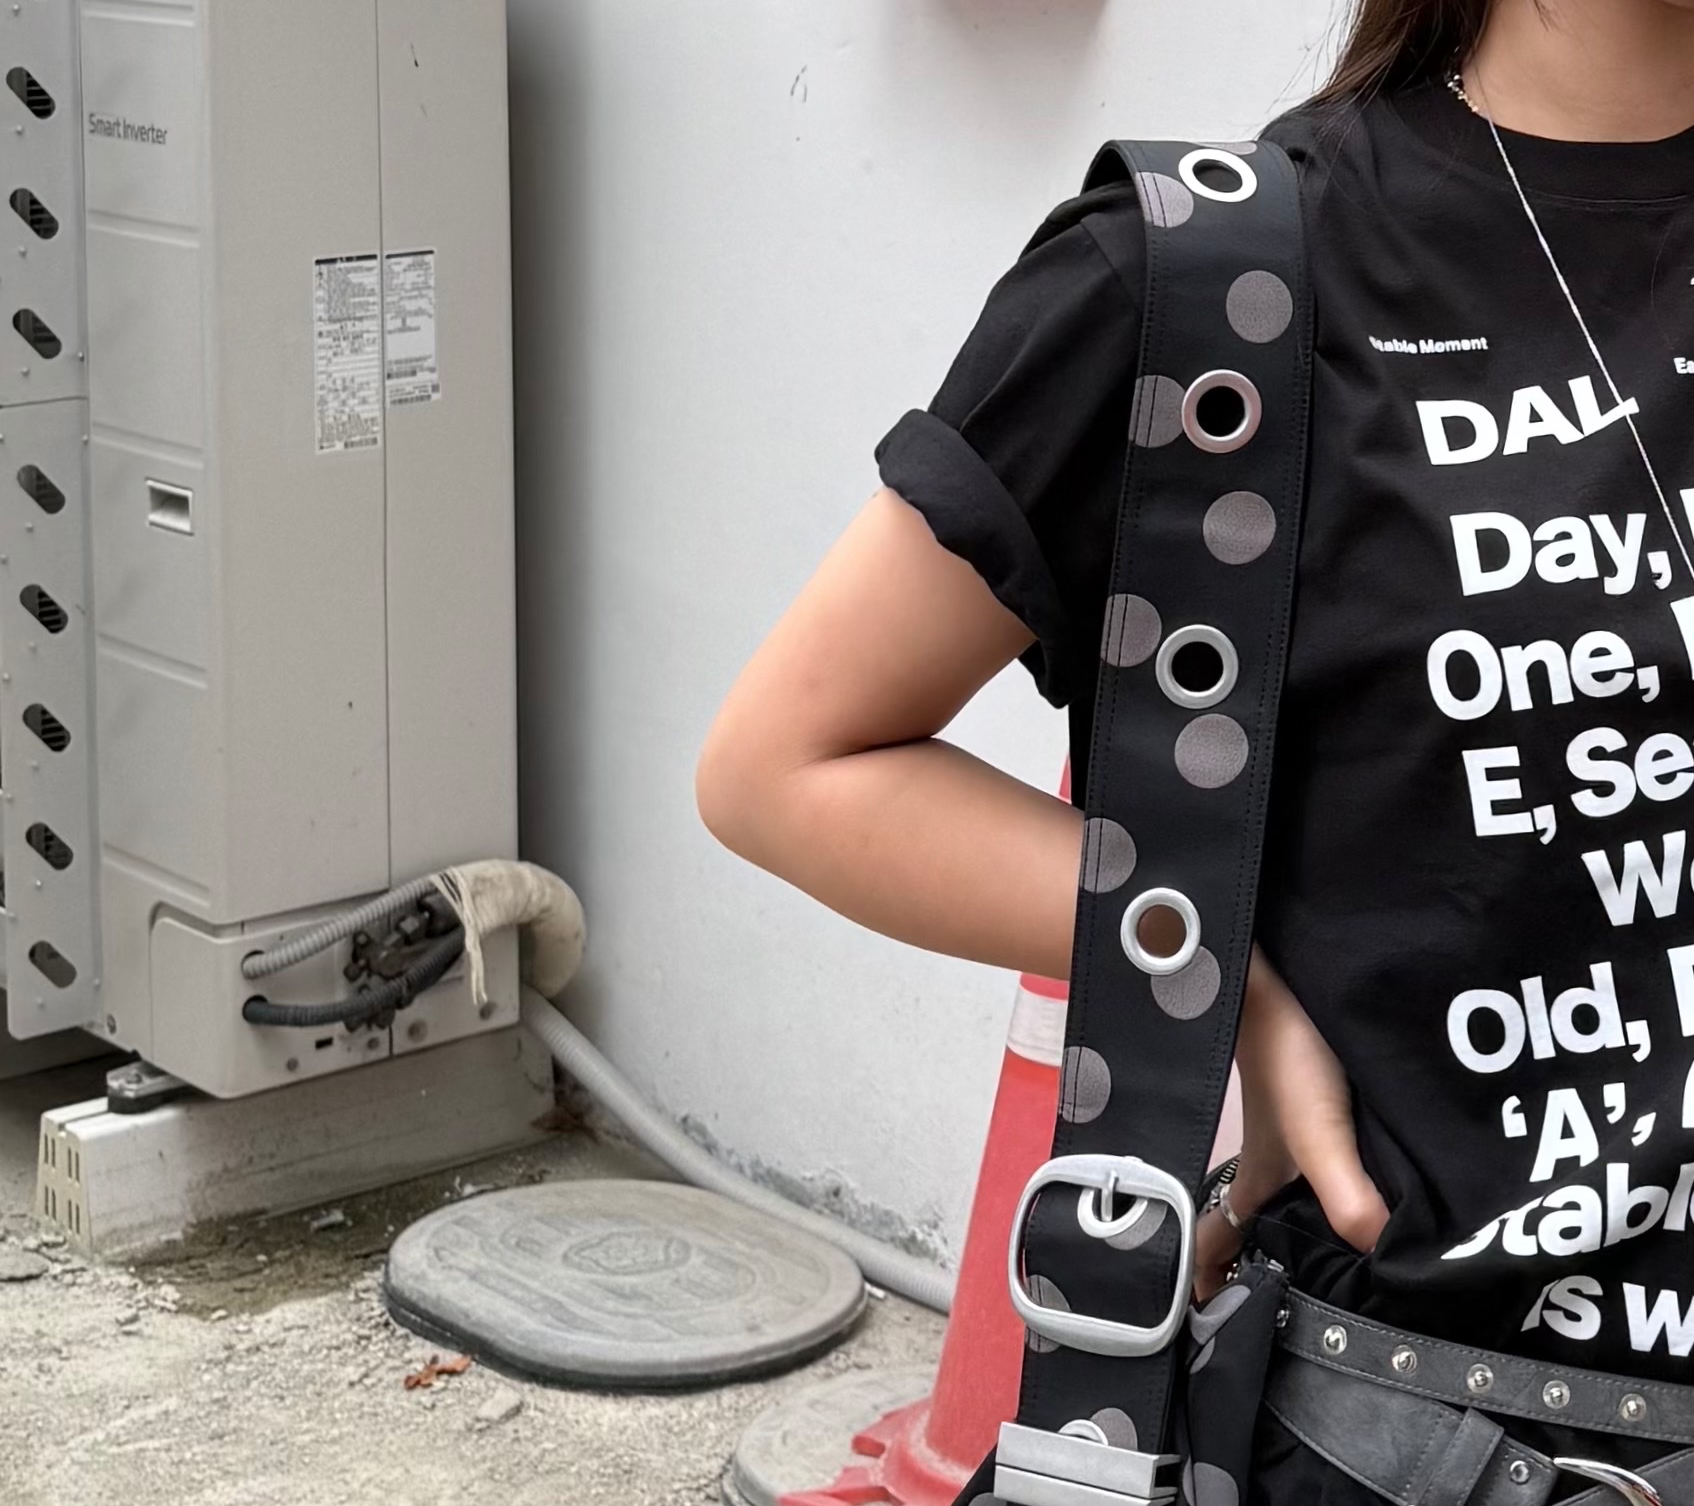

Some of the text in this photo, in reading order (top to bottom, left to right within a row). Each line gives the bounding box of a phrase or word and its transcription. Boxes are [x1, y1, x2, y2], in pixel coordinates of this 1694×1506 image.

[88, 113, 168, 146] Smart Inverter
[1418, 336, 1489, 355] Moment
[1450, 511, 1673, 597] Day,
[1426, 629, 1661, 721] One,
[1461, 745, 1557, 845] E,
[1447, 961, 1652, 1074] Old,
